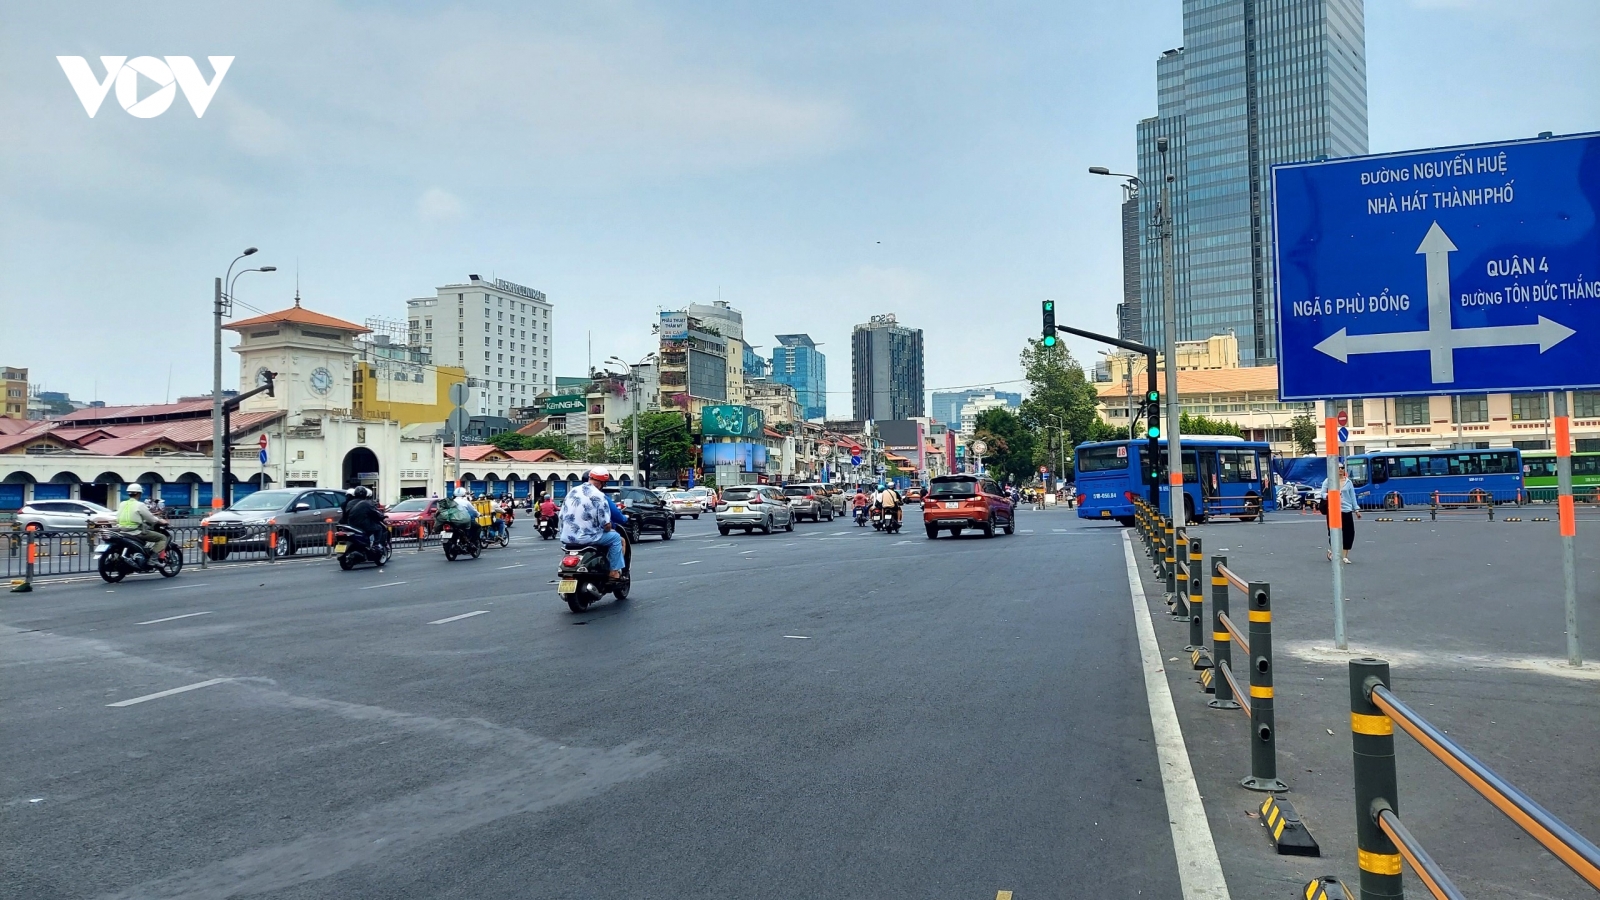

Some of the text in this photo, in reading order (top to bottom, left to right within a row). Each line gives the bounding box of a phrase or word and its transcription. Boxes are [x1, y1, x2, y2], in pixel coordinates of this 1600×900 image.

[1360, 151, 1508, 185] ĐƯỜNG NGUYỄN HUỆ
[1368, 192, 1398, 215] NHÀ
[1401, 190, 1428, 212] HÁT
[1486, 254, 1549, 279] QUẬN 4
[1293, 287, 1410, 317] NGÃ 6 PHÙ ĐỔNG
[1461, 273, 1600, 307] ĐƯỜNG TÔN ĐỨC THẮNG
[1117, 447, 1126, 456] 18
